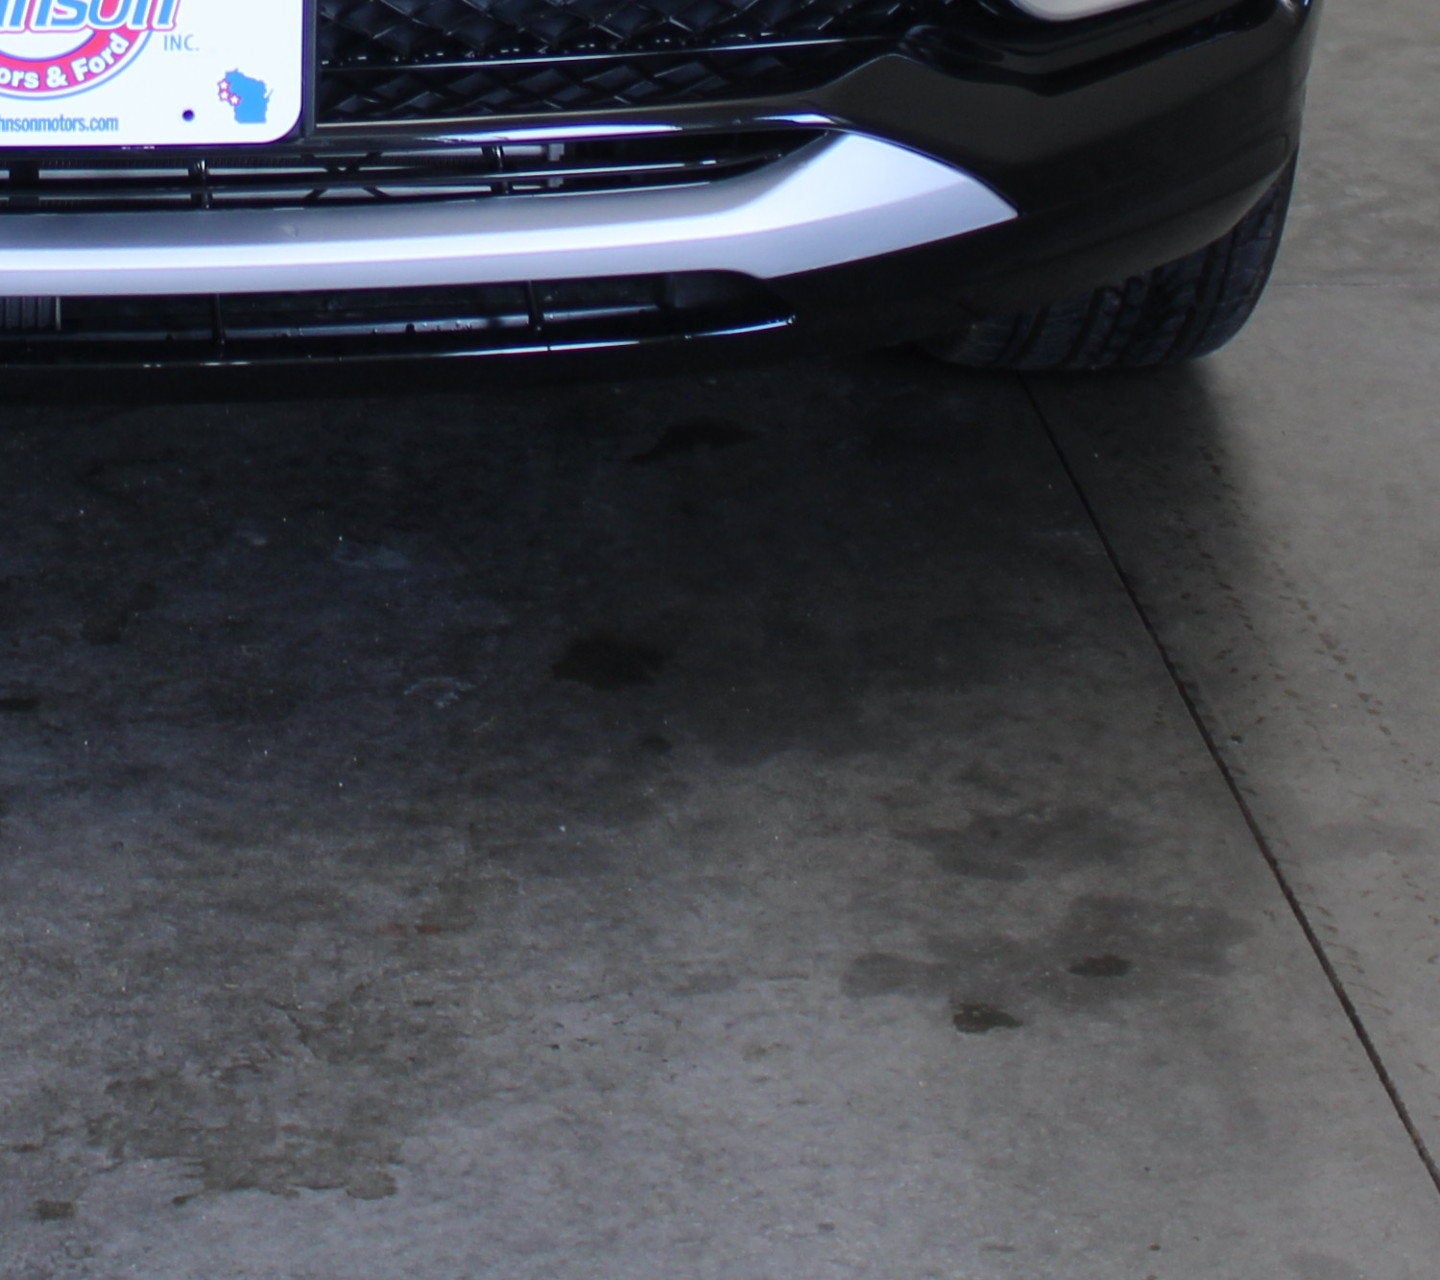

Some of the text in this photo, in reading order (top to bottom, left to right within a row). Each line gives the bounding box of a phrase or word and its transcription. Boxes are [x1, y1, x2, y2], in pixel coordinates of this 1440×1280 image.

[46, 65, 69, 89] &
[71, 32, 130, 83] Ford
[163, 34, 200, 52] INC.
